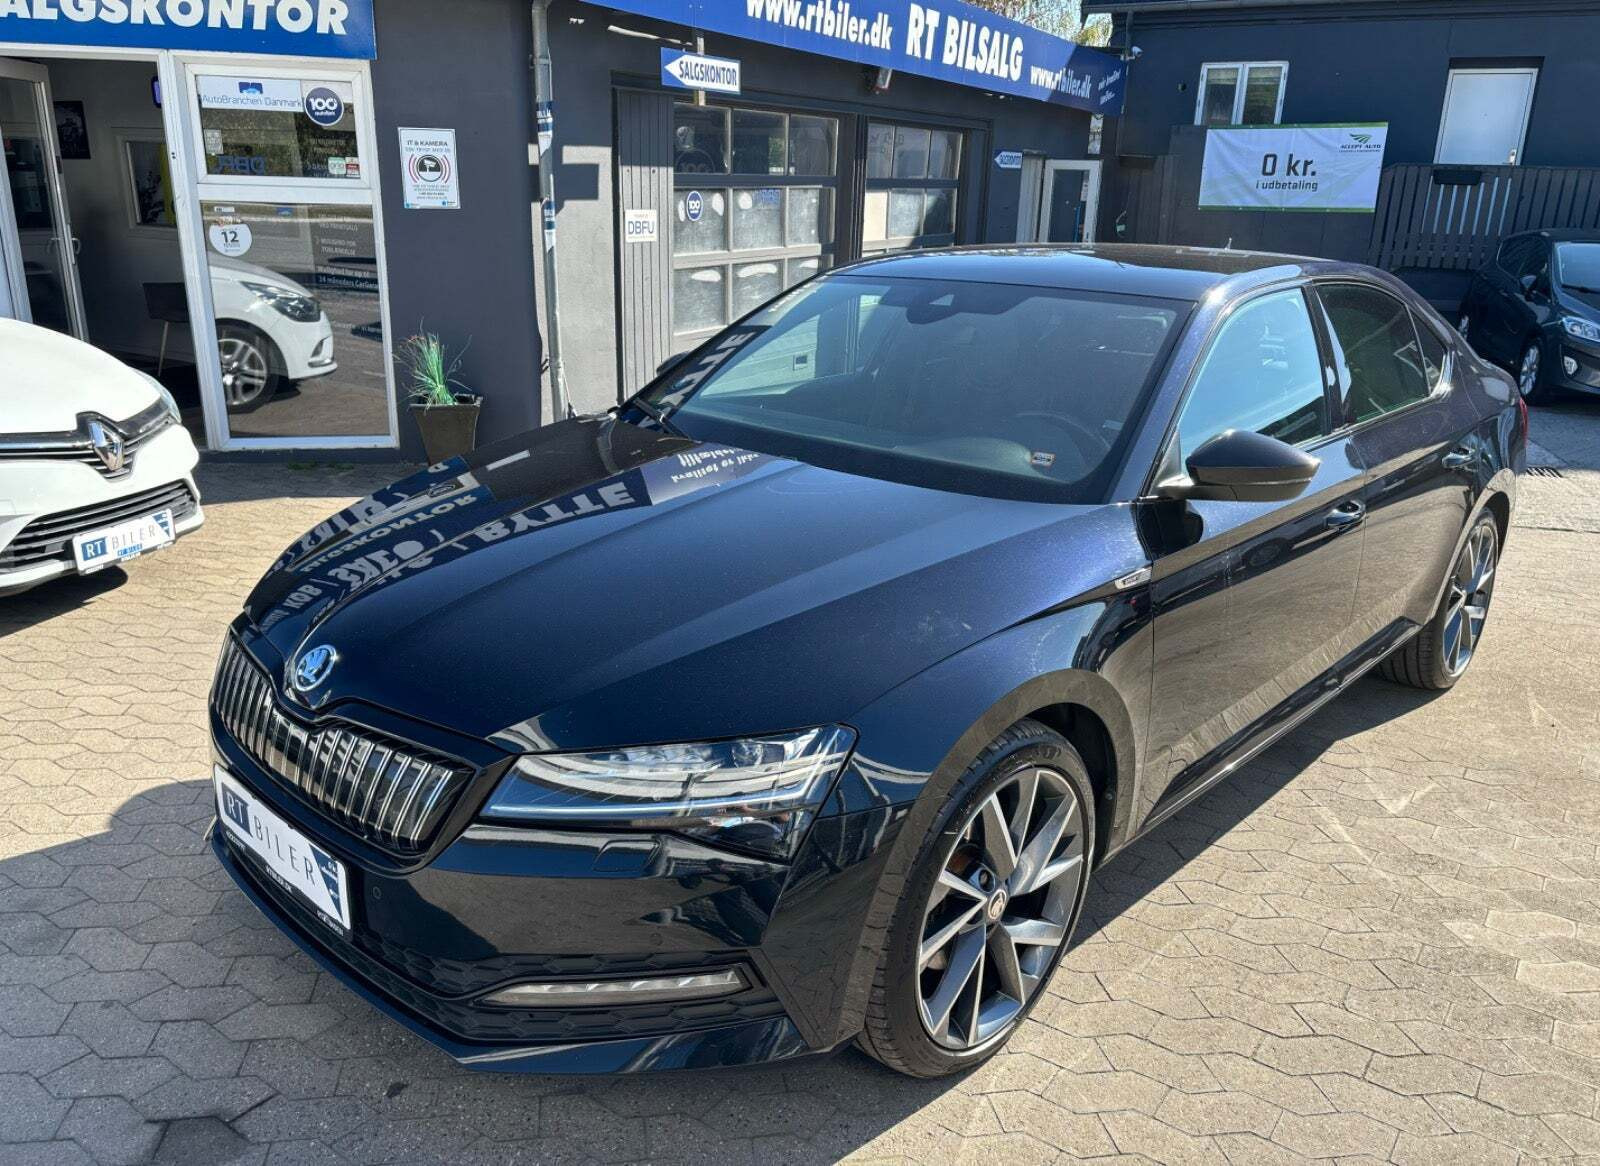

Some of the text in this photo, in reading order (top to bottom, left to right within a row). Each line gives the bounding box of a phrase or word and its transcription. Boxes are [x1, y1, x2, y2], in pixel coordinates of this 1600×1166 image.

[747, 0, 893, 50] www.rtbiler.dk
[906, 3, 1023, 81] RT BILSALG
[679, 60, 737, 86] SALGSKONTOR
[1286, 153, 1317, 176] kr.
[1261, 180, 1318, 192] udbetaling
[221, 231, 239, 243] 12
[628, 220, 655, 235] DBFU
[85, 540, 104, 558] RT
[111, 524, 155, 550] BILER
[225, 791, 248, 825] RT
[254, 815, 316, 887] BILER
